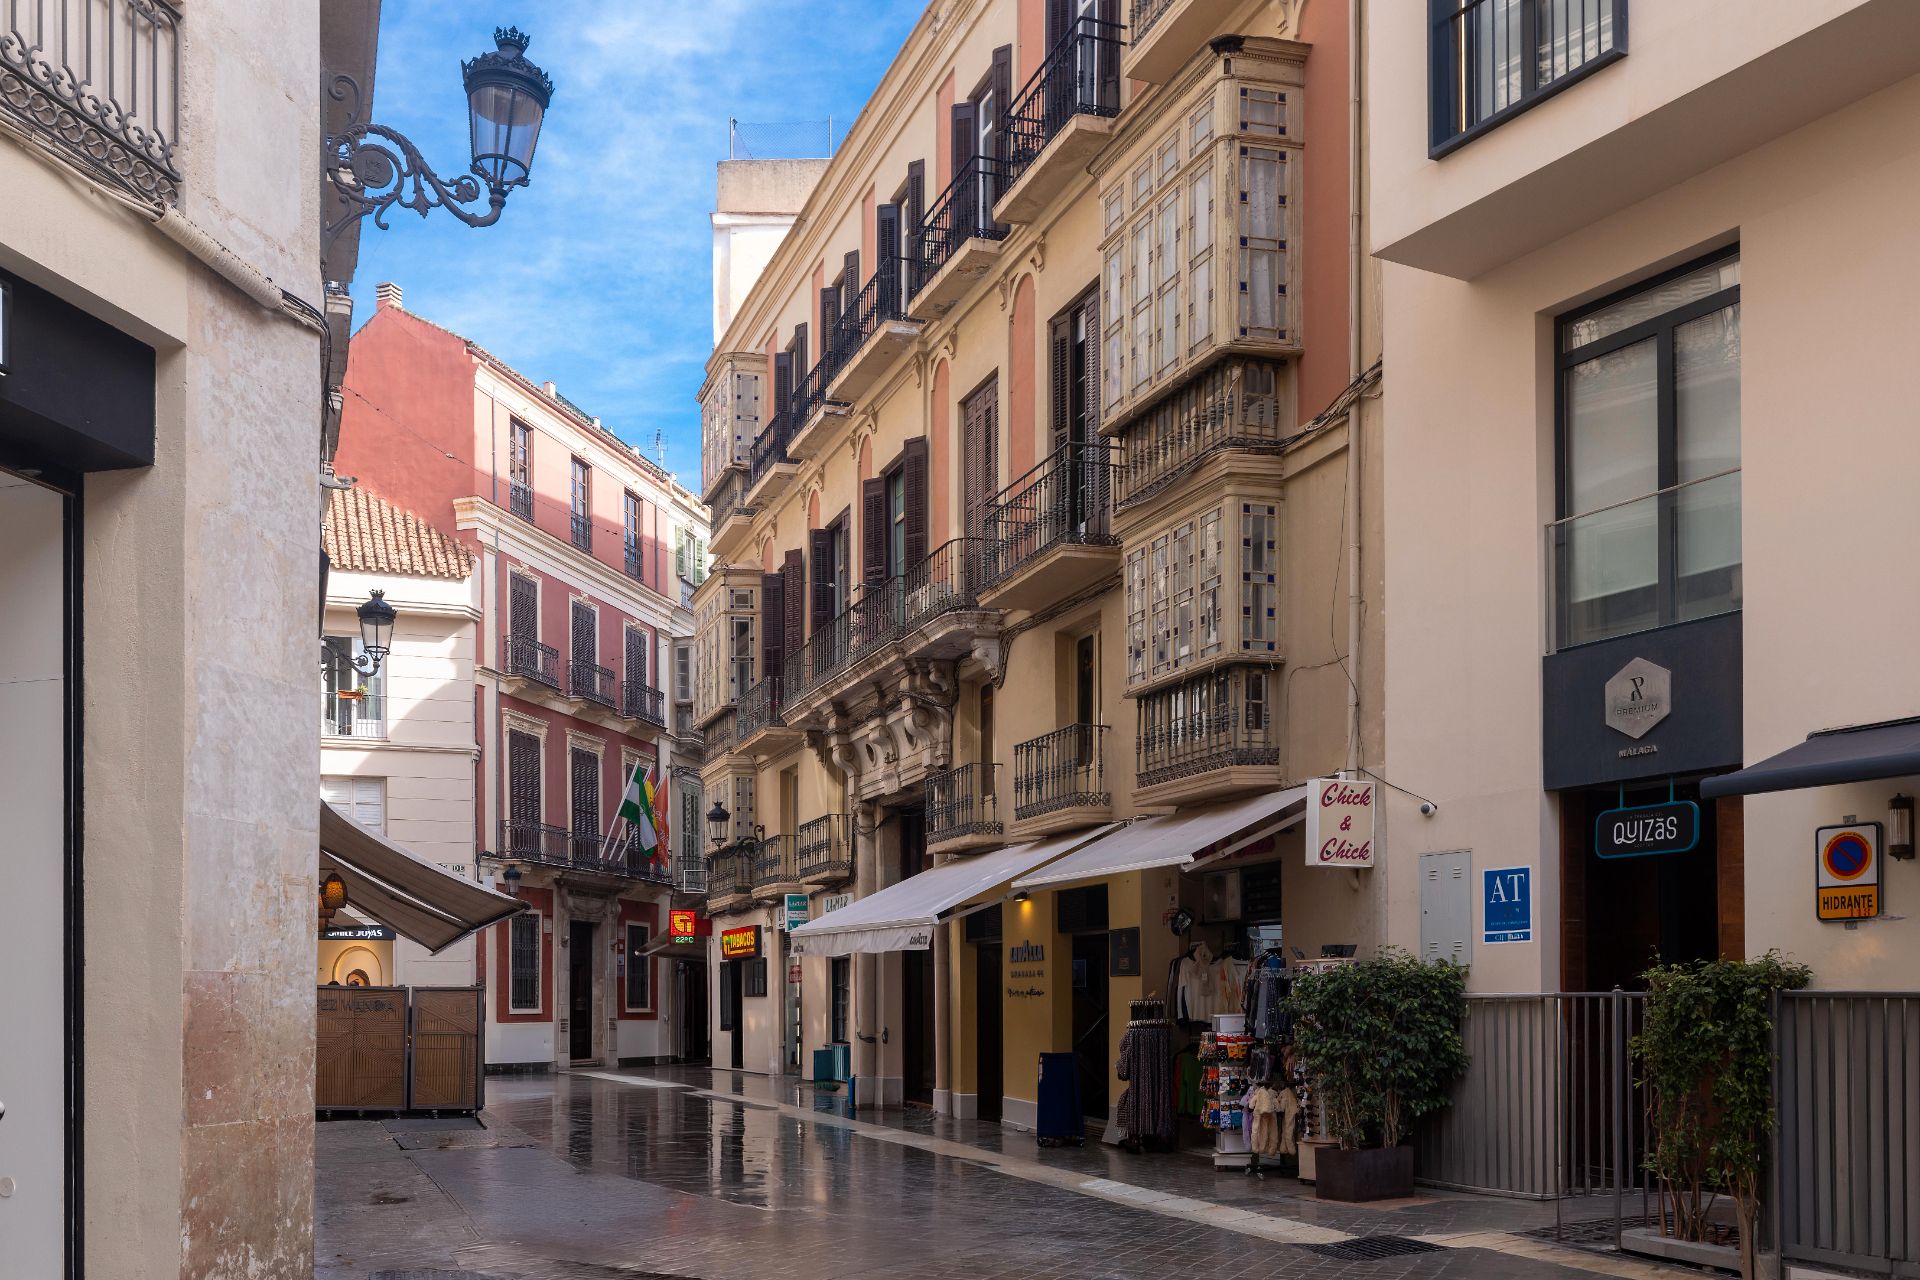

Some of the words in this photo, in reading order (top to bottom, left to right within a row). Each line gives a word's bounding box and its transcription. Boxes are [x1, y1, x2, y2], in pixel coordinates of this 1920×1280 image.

[1616, 703, 1658, 715] PREMIUM
[1321, 783, 1371, 807] Chick
[1340, 816, 1351, 831] &
[1320, 838, 1370, 861] Chick
[1489, 873, 1525, 903] AT
[1822, 894, 1873, 910] HIDRANTE
[729, 930, 755, 949] TABACOS
